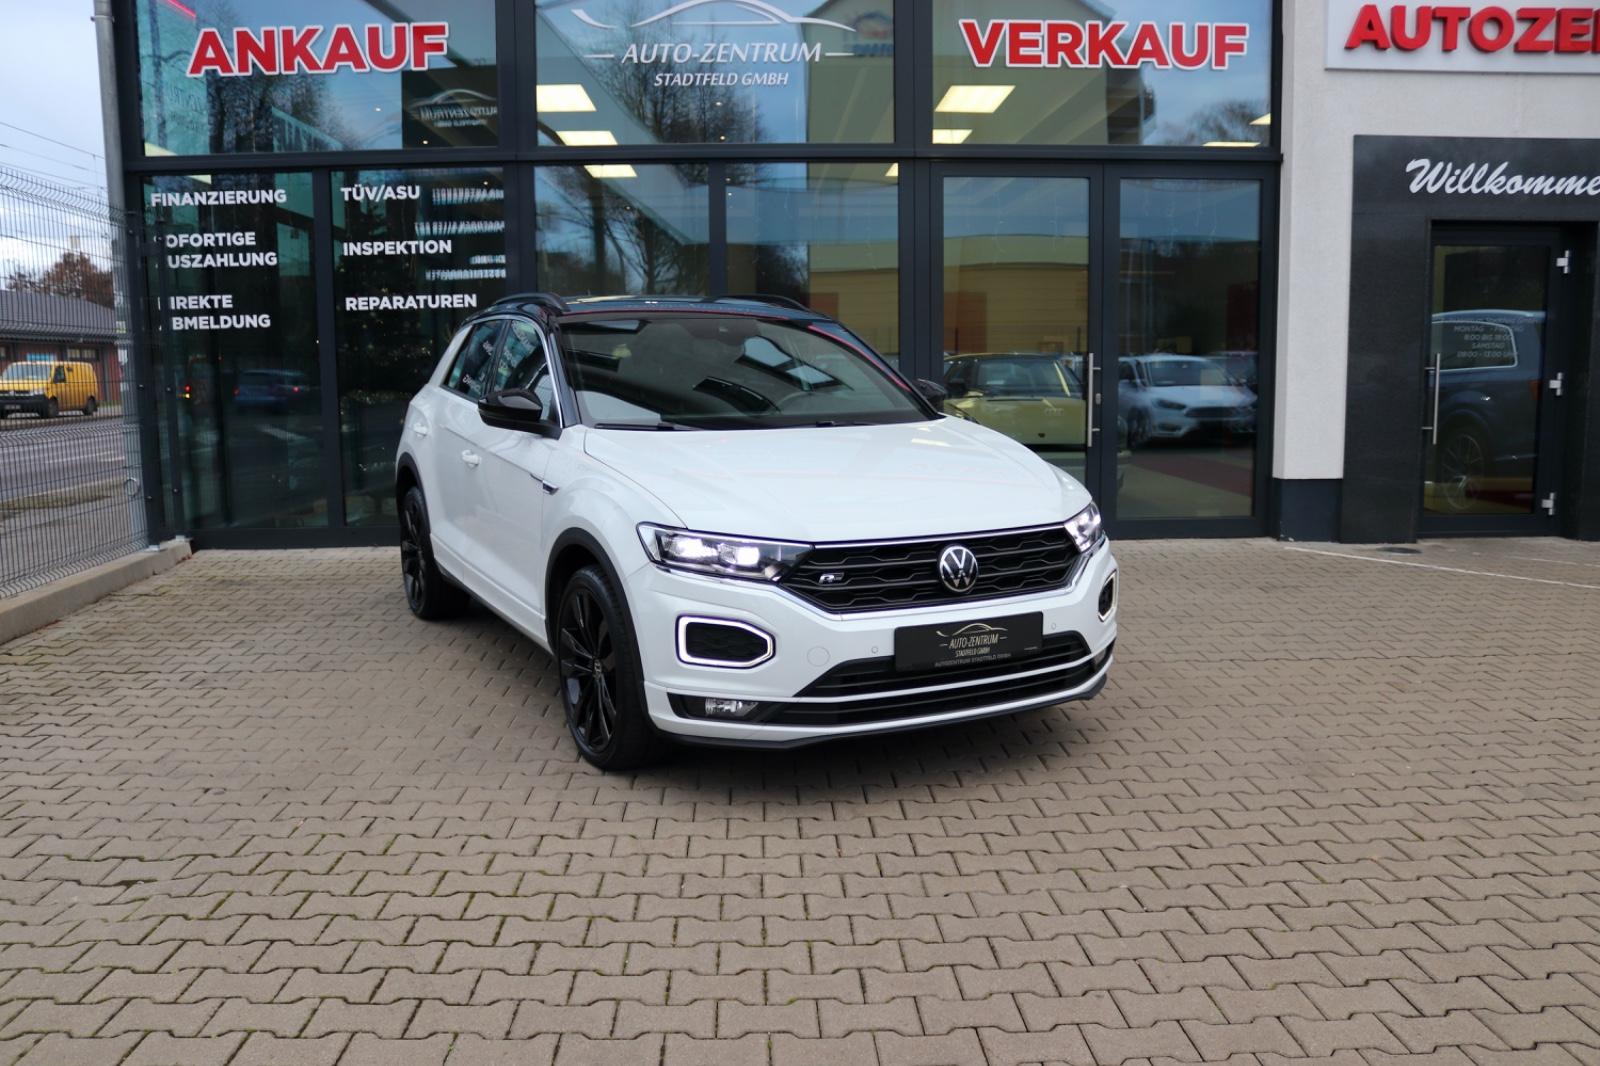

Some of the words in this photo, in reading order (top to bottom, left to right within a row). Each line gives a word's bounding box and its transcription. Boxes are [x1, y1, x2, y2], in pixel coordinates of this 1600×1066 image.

[186, 22, 449, 77] ANKAUF
[621, 42, 822, 64] AUTO-ZENTRUM
[958, 19, 1250, 71] VERKAUF
[654, 72, 738, 87] STADTFELD
[741, 72, 789, 86] GMBH
[1405, 158, 1600, 196] Willkomme
[150, 189, 287, 207] FINANZIERUNG
[340, 184, 420, 202] TÜV/ASU
[153, 231, 256, 249] OFORTIGE
[342, 239, 452, 257] INSPEKTION
[155, 251, 278, 270] USZAHLUNG
[157, 294, 233, 311] IREKTE
[345, 293, 477, 312] REPARATUREN
[159, 313, 271, 332] BMELDUNG
